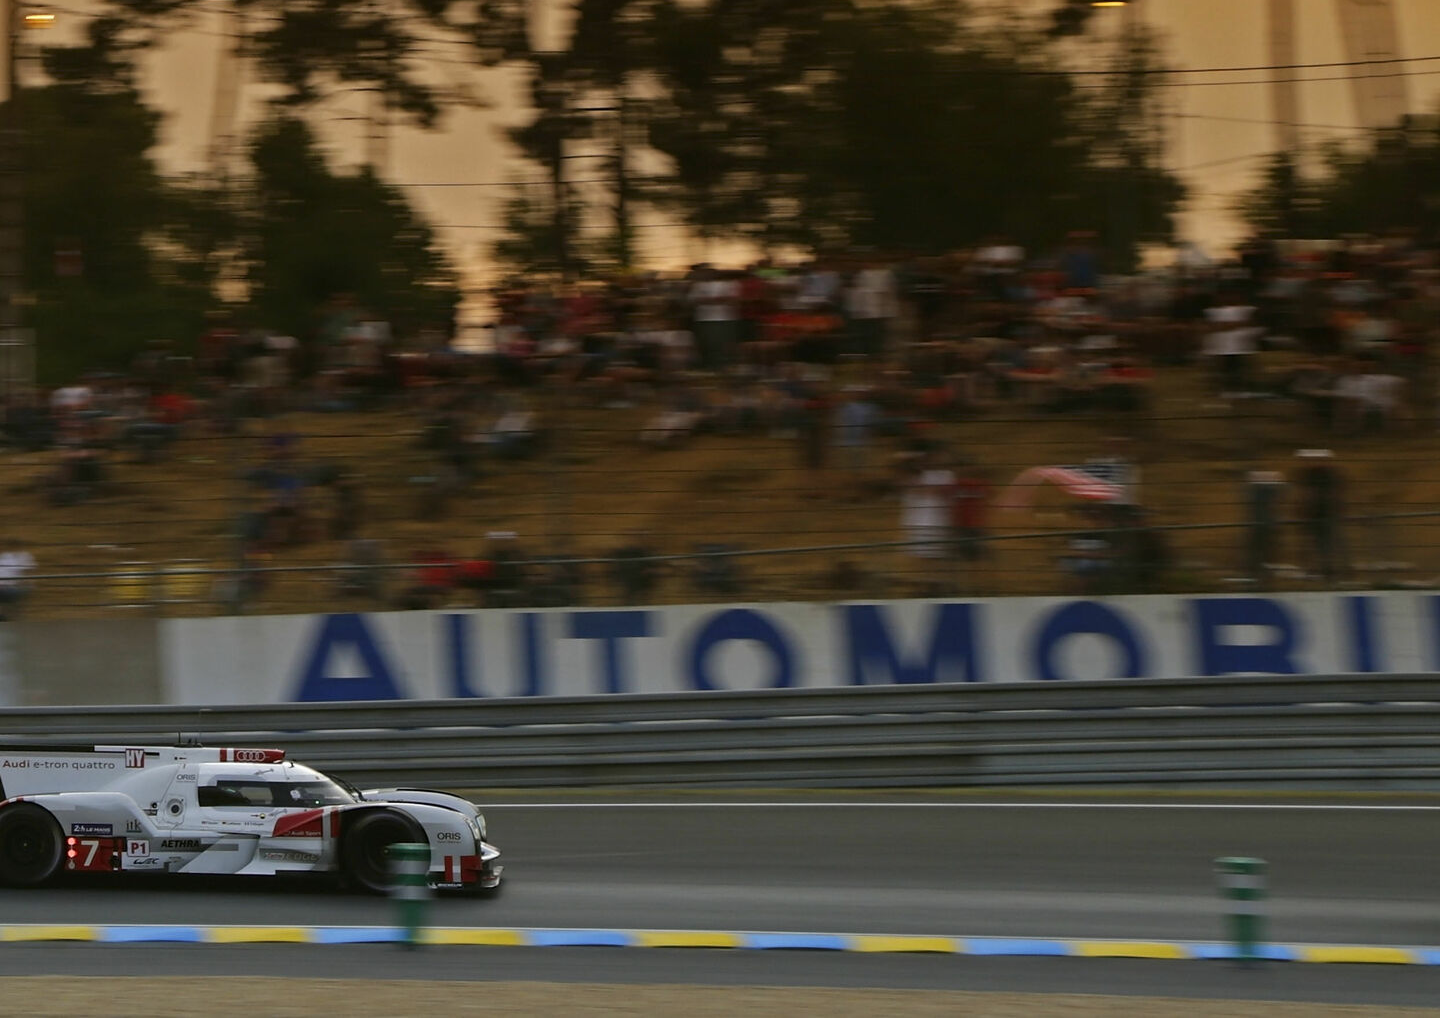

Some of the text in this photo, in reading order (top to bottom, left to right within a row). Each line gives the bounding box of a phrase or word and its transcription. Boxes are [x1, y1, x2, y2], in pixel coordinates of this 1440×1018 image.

[288, 596, 1440, 702] AUTOMOBI
[125, 749, 144, 767] HY
[2, 760, 116, 770] Audi e-tron quattro
[176, 773, 197, 781] ORIS
[437, 832, 461, 841] ORIS
[131, 842, 146, 855] P1
[161, 839, 200, 848] AETHRA
[80, 839, 100, 867] 7
